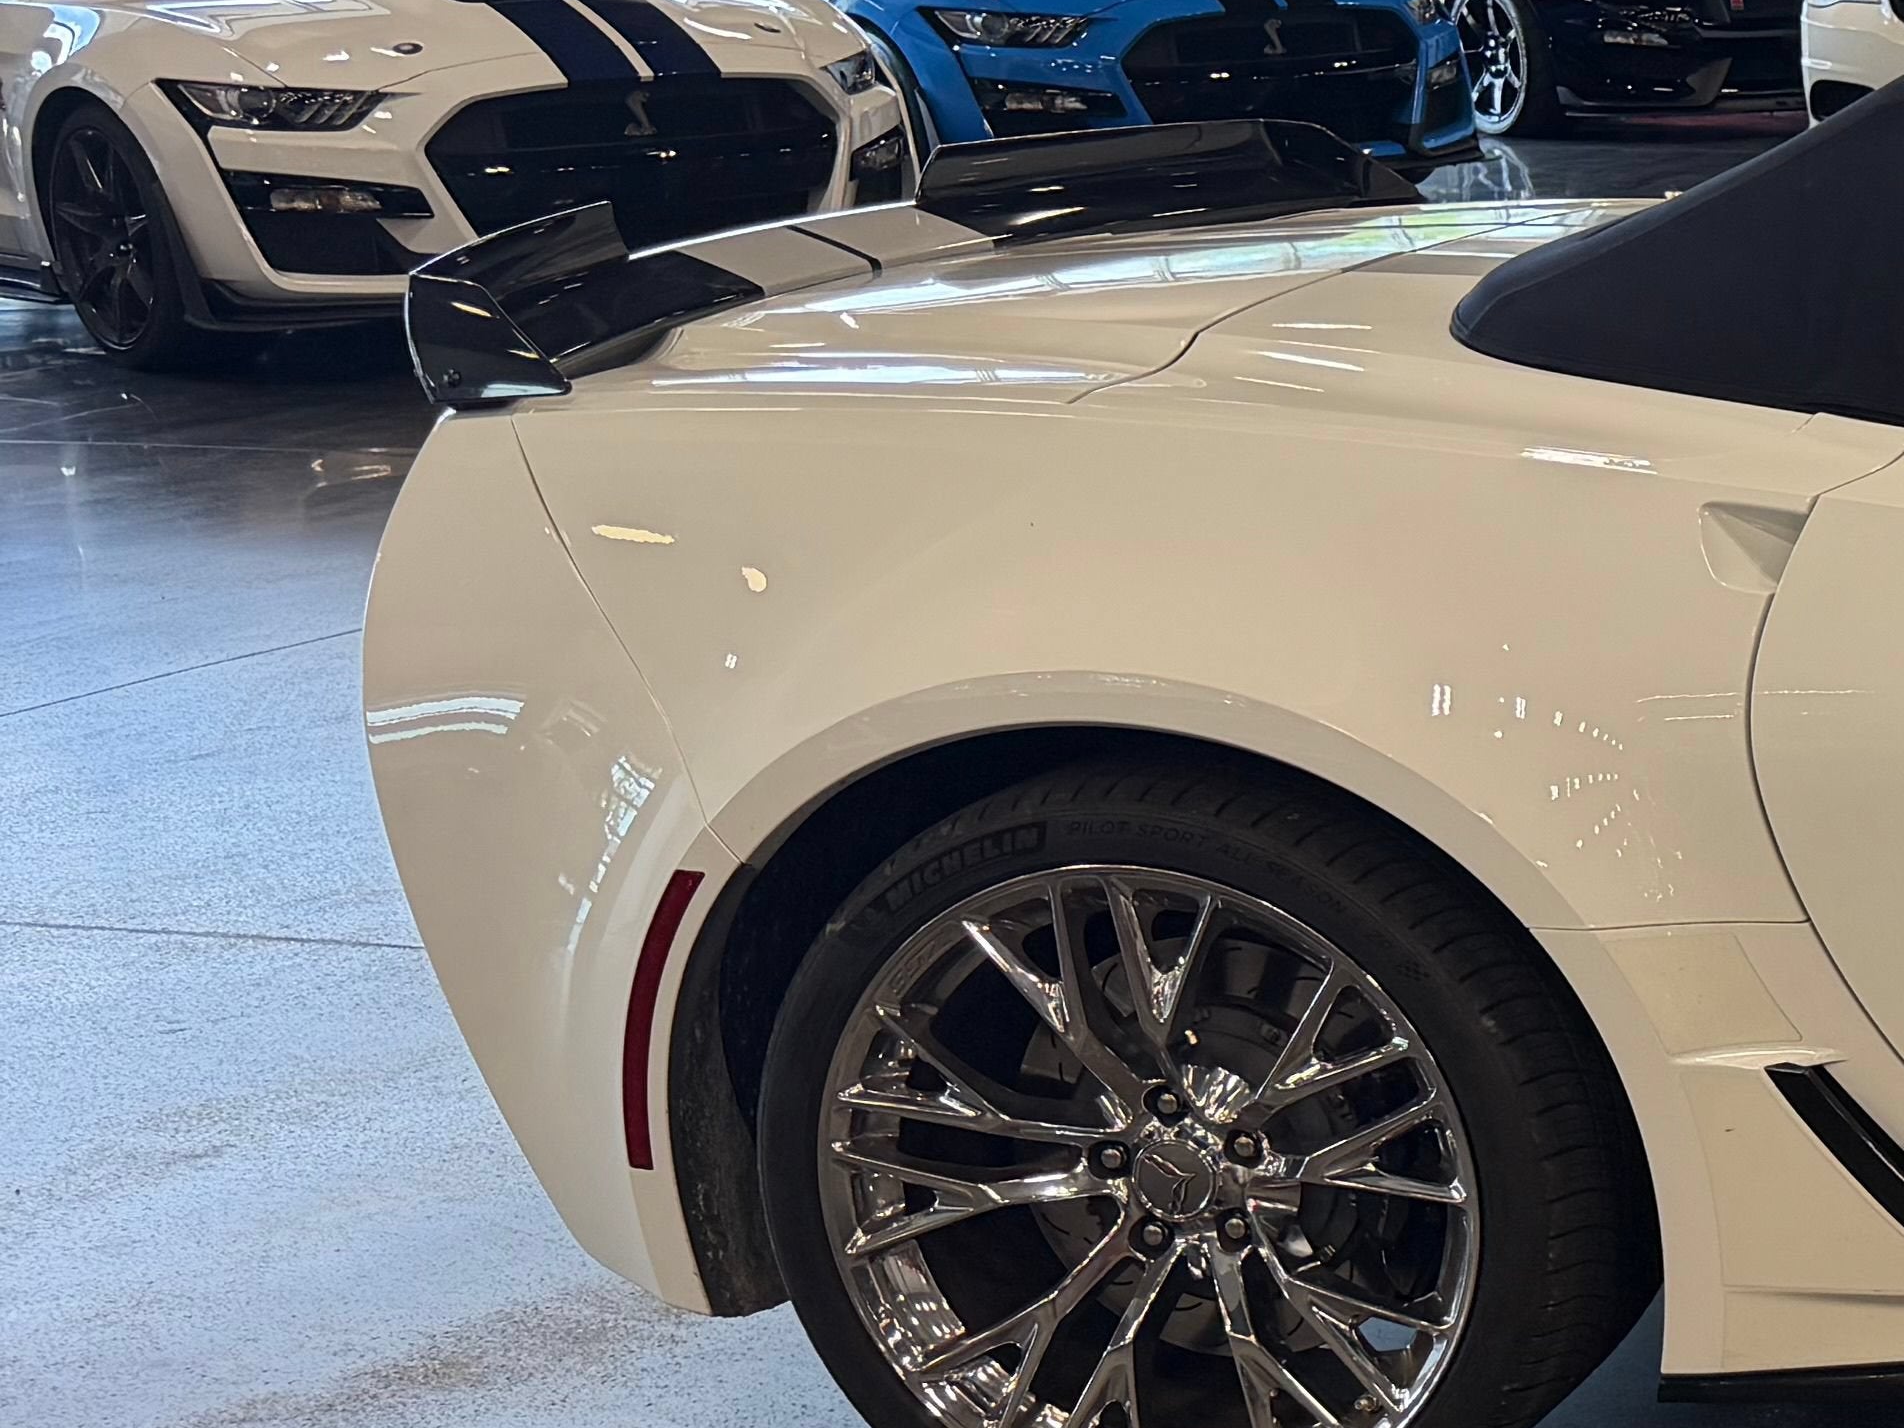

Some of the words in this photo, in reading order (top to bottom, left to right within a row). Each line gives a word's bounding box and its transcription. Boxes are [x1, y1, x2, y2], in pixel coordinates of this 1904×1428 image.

[884, 826, 1040, 905] MICHELIN
[1069, 820, 1130, 836] PILOT
[1136, 822, 1210, 848] SPORT
[1215, 843, 1256, 864] ALL
